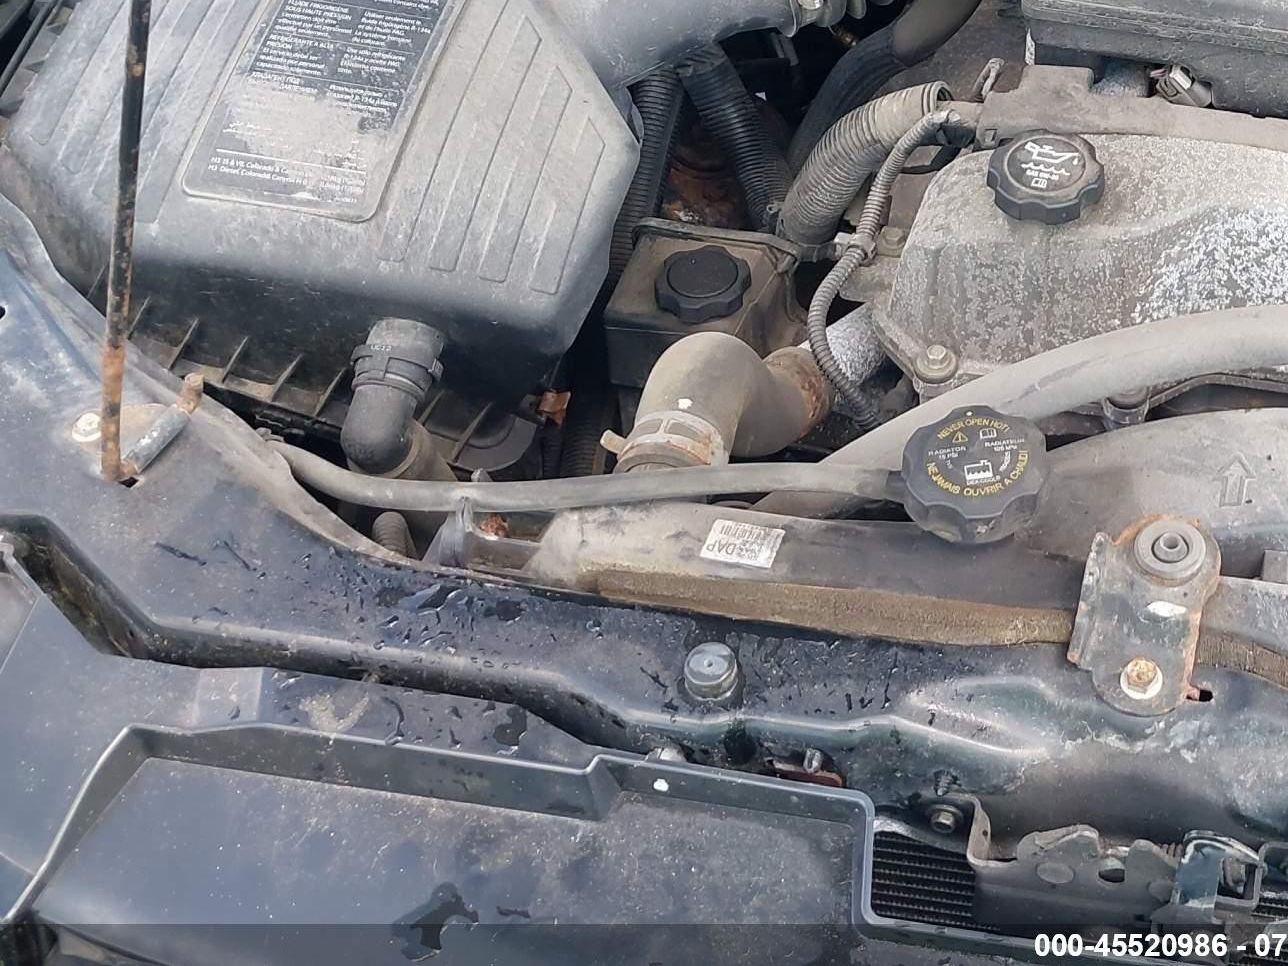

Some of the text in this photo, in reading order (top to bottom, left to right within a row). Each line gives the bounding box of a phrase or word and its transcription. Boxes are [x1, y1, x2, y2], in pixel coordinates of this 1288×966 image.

[937, 418, 1011, 440] NEVER OPEN HOT!
[928, 446, 966, 456] RADIATOR
[932, 474, 961, 494] JAMAIS
[963, 482, 1005, 497] OUVRIR
